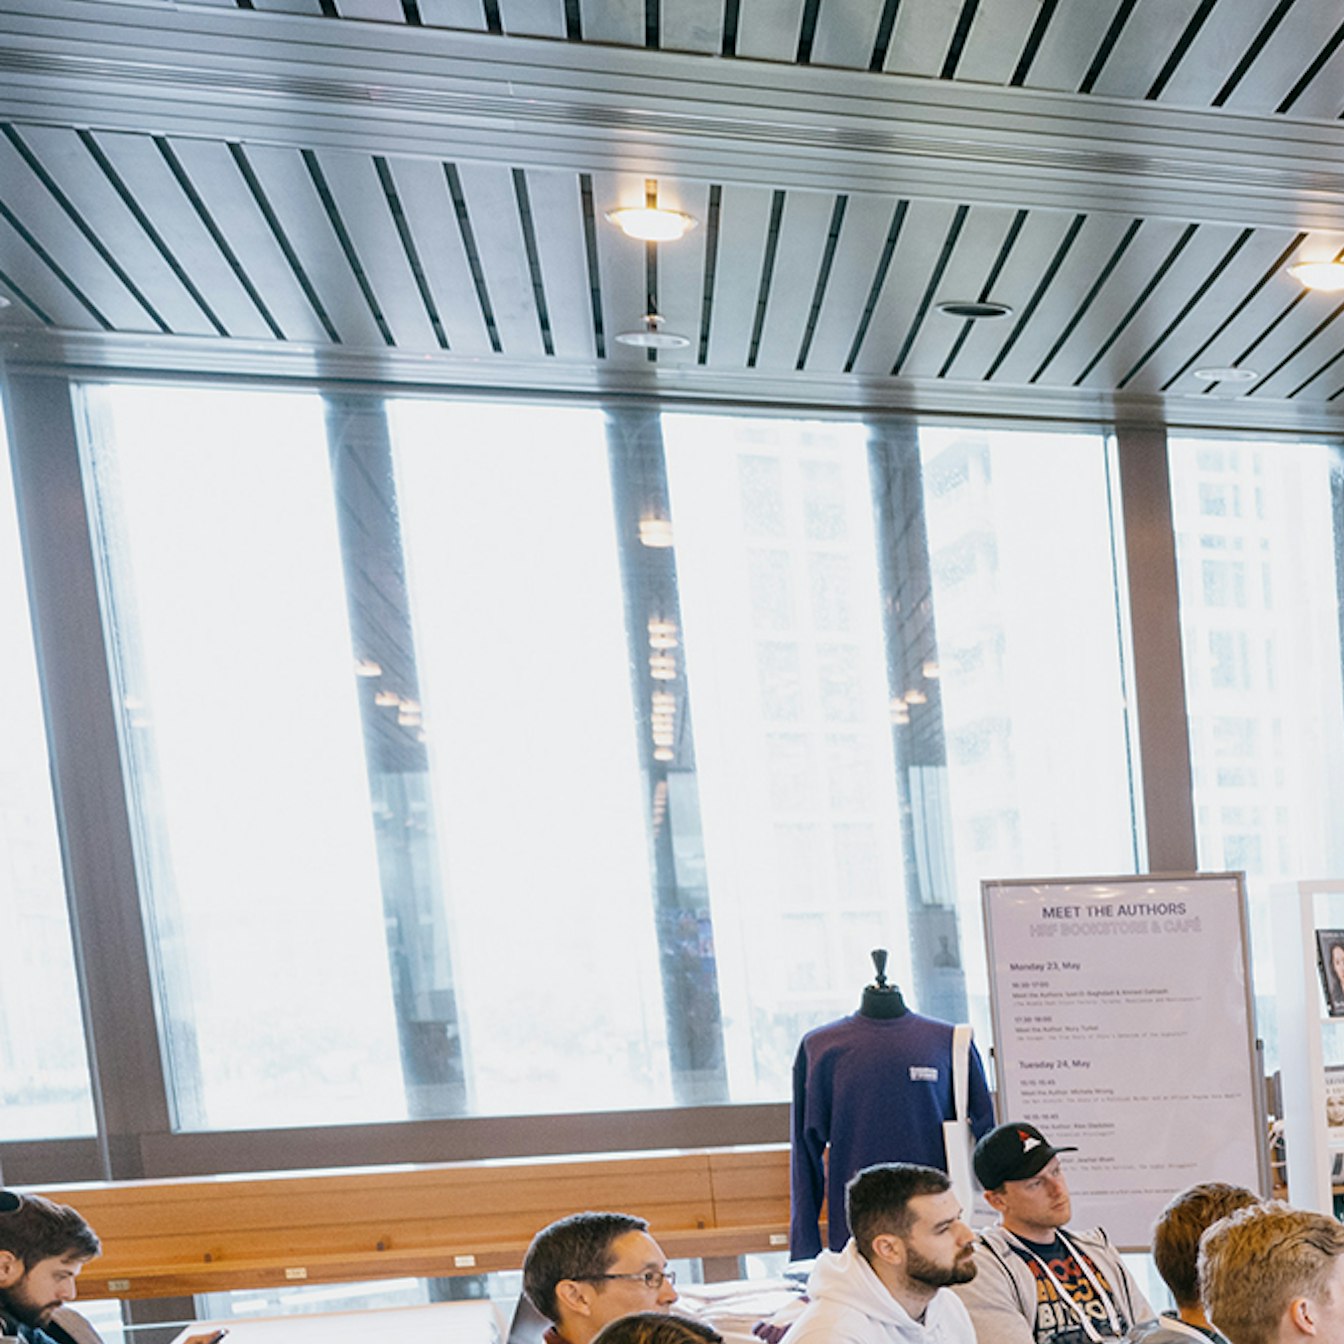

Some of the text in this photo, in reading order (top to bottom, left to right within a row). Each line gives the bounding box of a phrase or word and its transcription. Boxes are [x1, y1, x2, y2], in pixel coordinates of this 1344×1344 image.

[1042, 902, 1186, 918] MEET THE AUTHORS
[1010, 962, 1080, 972] Monday 23, May
[1019, 1060, 1090, 1070] Tuesday 24, May
